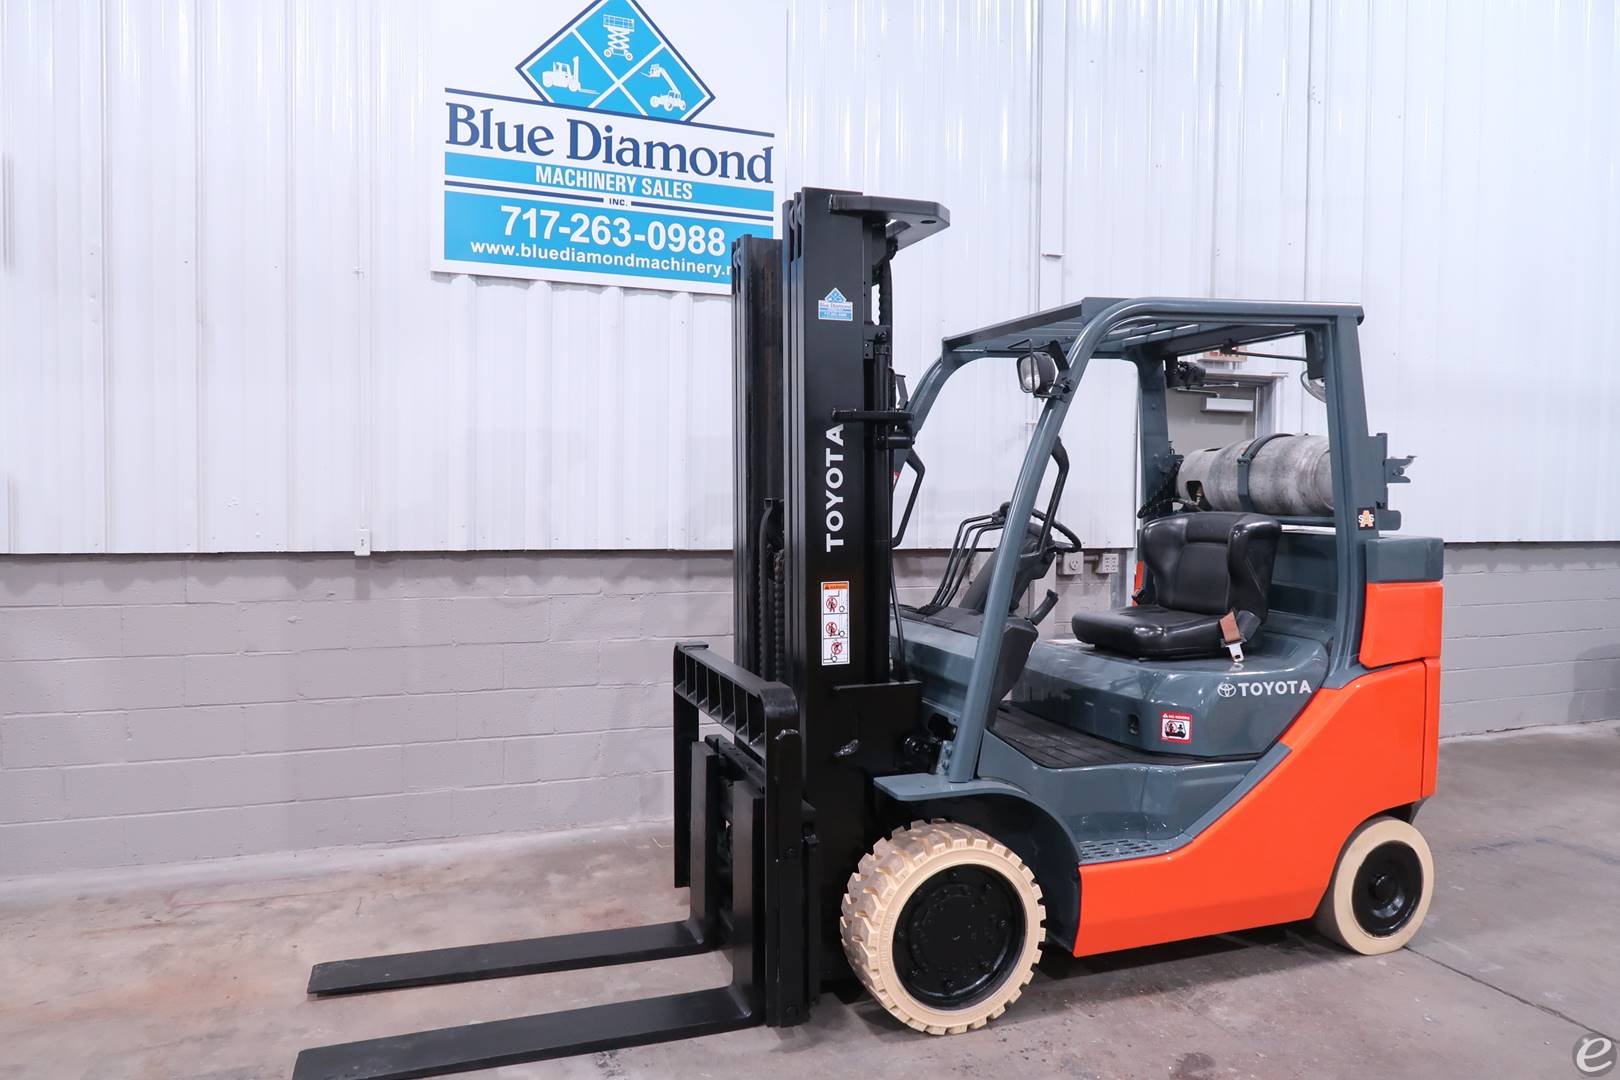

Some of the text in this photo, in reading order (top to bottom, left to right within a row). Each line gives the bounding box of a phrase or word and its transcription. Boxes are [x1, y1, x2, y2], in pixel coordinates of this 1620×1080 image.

[445, 102, 774, 184] Blue Diamond
[535, 165, 693, 200] MACHINERY SALES
[608, 198, 628, 207] INC.
[500, 205, 726, 257] 717-263-0988
[825, 423, 845, 553] TOYOTA
[1237, 680, 1312, 697] TOYOTA
